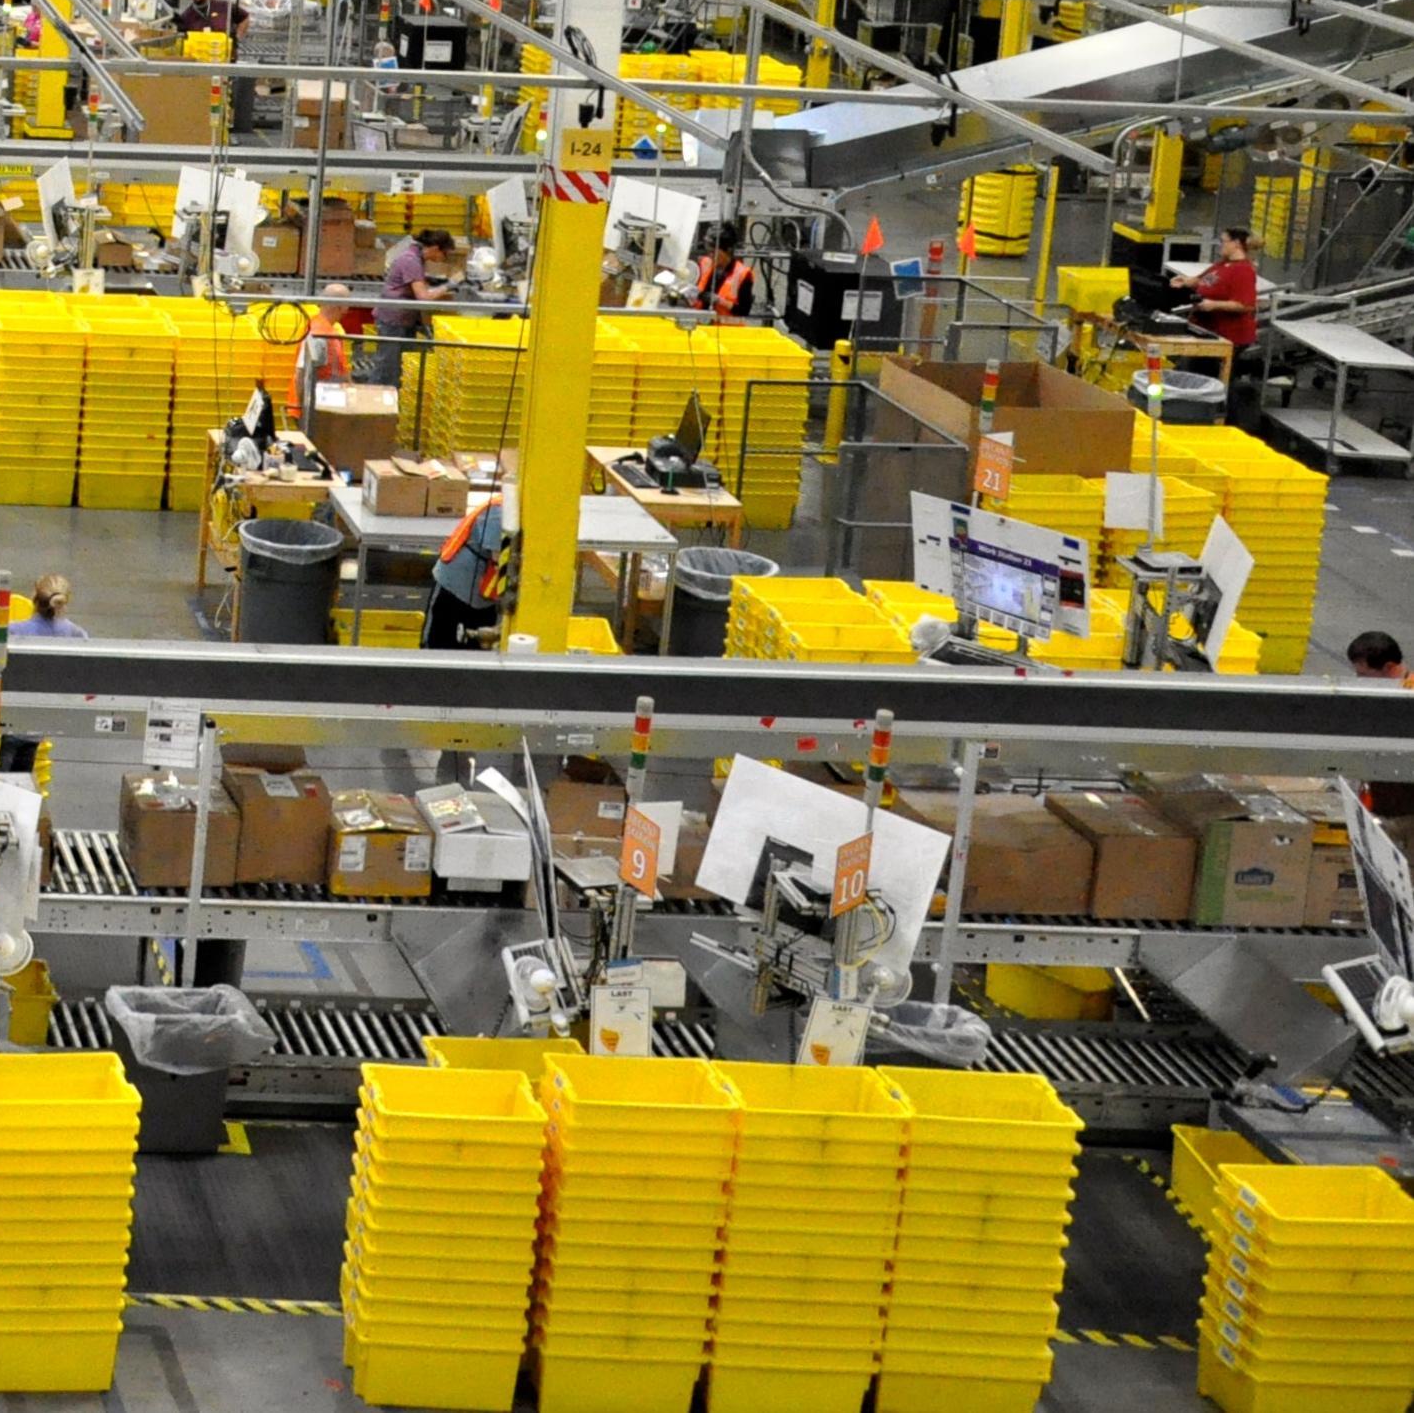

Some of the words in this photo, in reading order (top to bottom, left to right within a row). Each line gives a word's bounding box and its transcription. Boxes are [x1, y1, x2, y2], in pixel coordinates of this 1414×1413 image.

[570, 141, 602, 157] I-24
[983, 468, 1000, 492] 21
[632, 849, 646, 879] 9
[837, 870, 864, 905] 10
[610, 989, 633, 998] LAST
